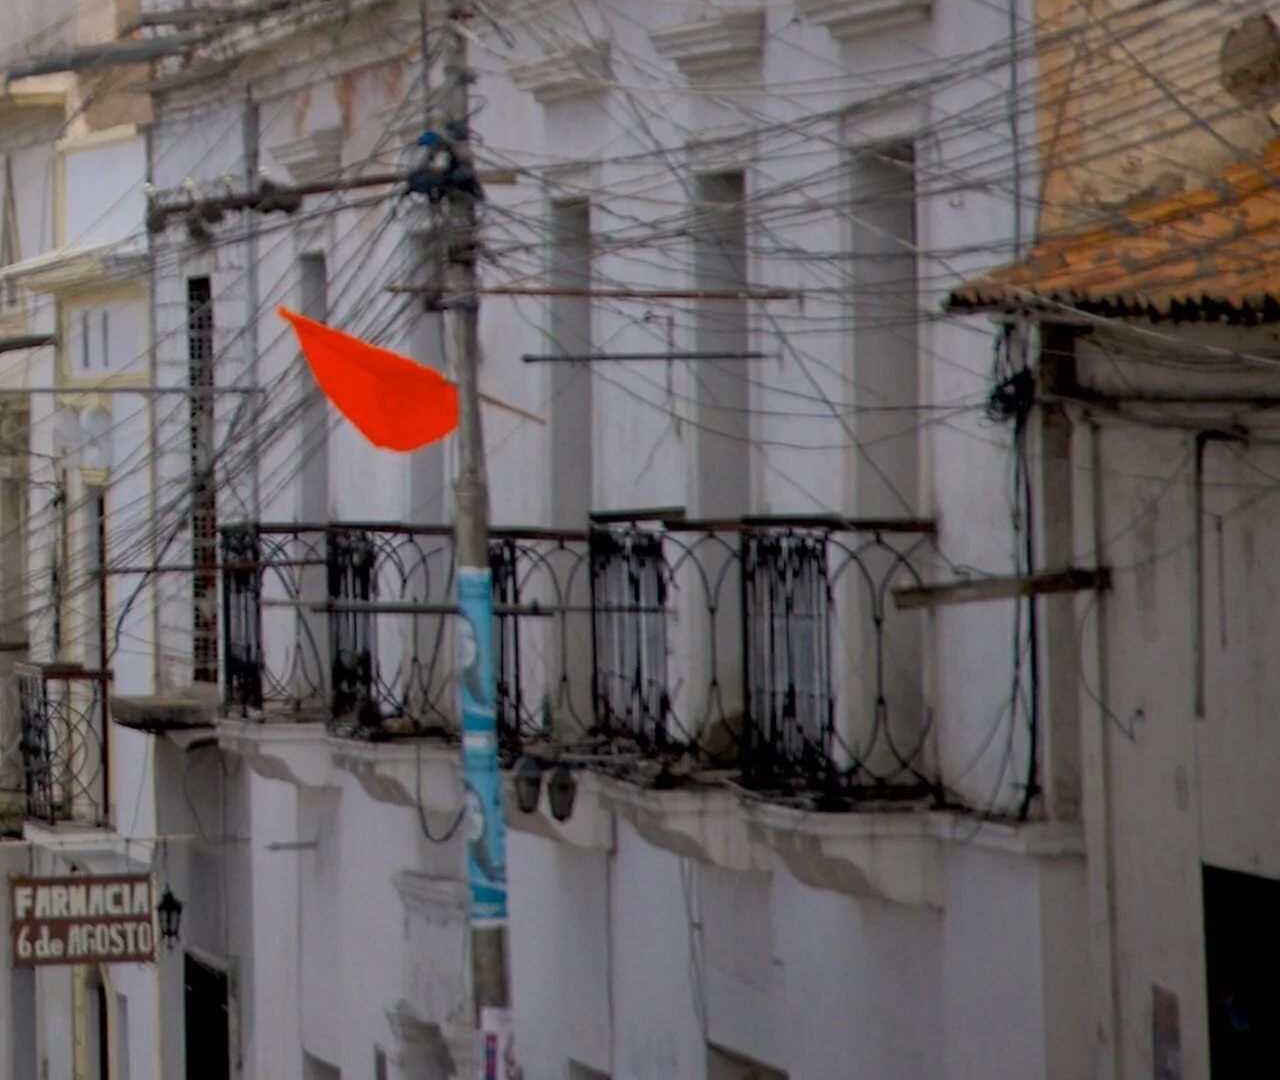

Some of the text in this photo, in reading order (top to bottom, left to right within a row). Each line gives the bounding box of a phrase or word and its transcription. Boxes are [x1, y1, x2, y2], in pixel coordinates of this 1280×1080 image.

[14, 881, 150, 919] FARMACIA
[17, 921, 153, 959] 6 de AGOSTO
